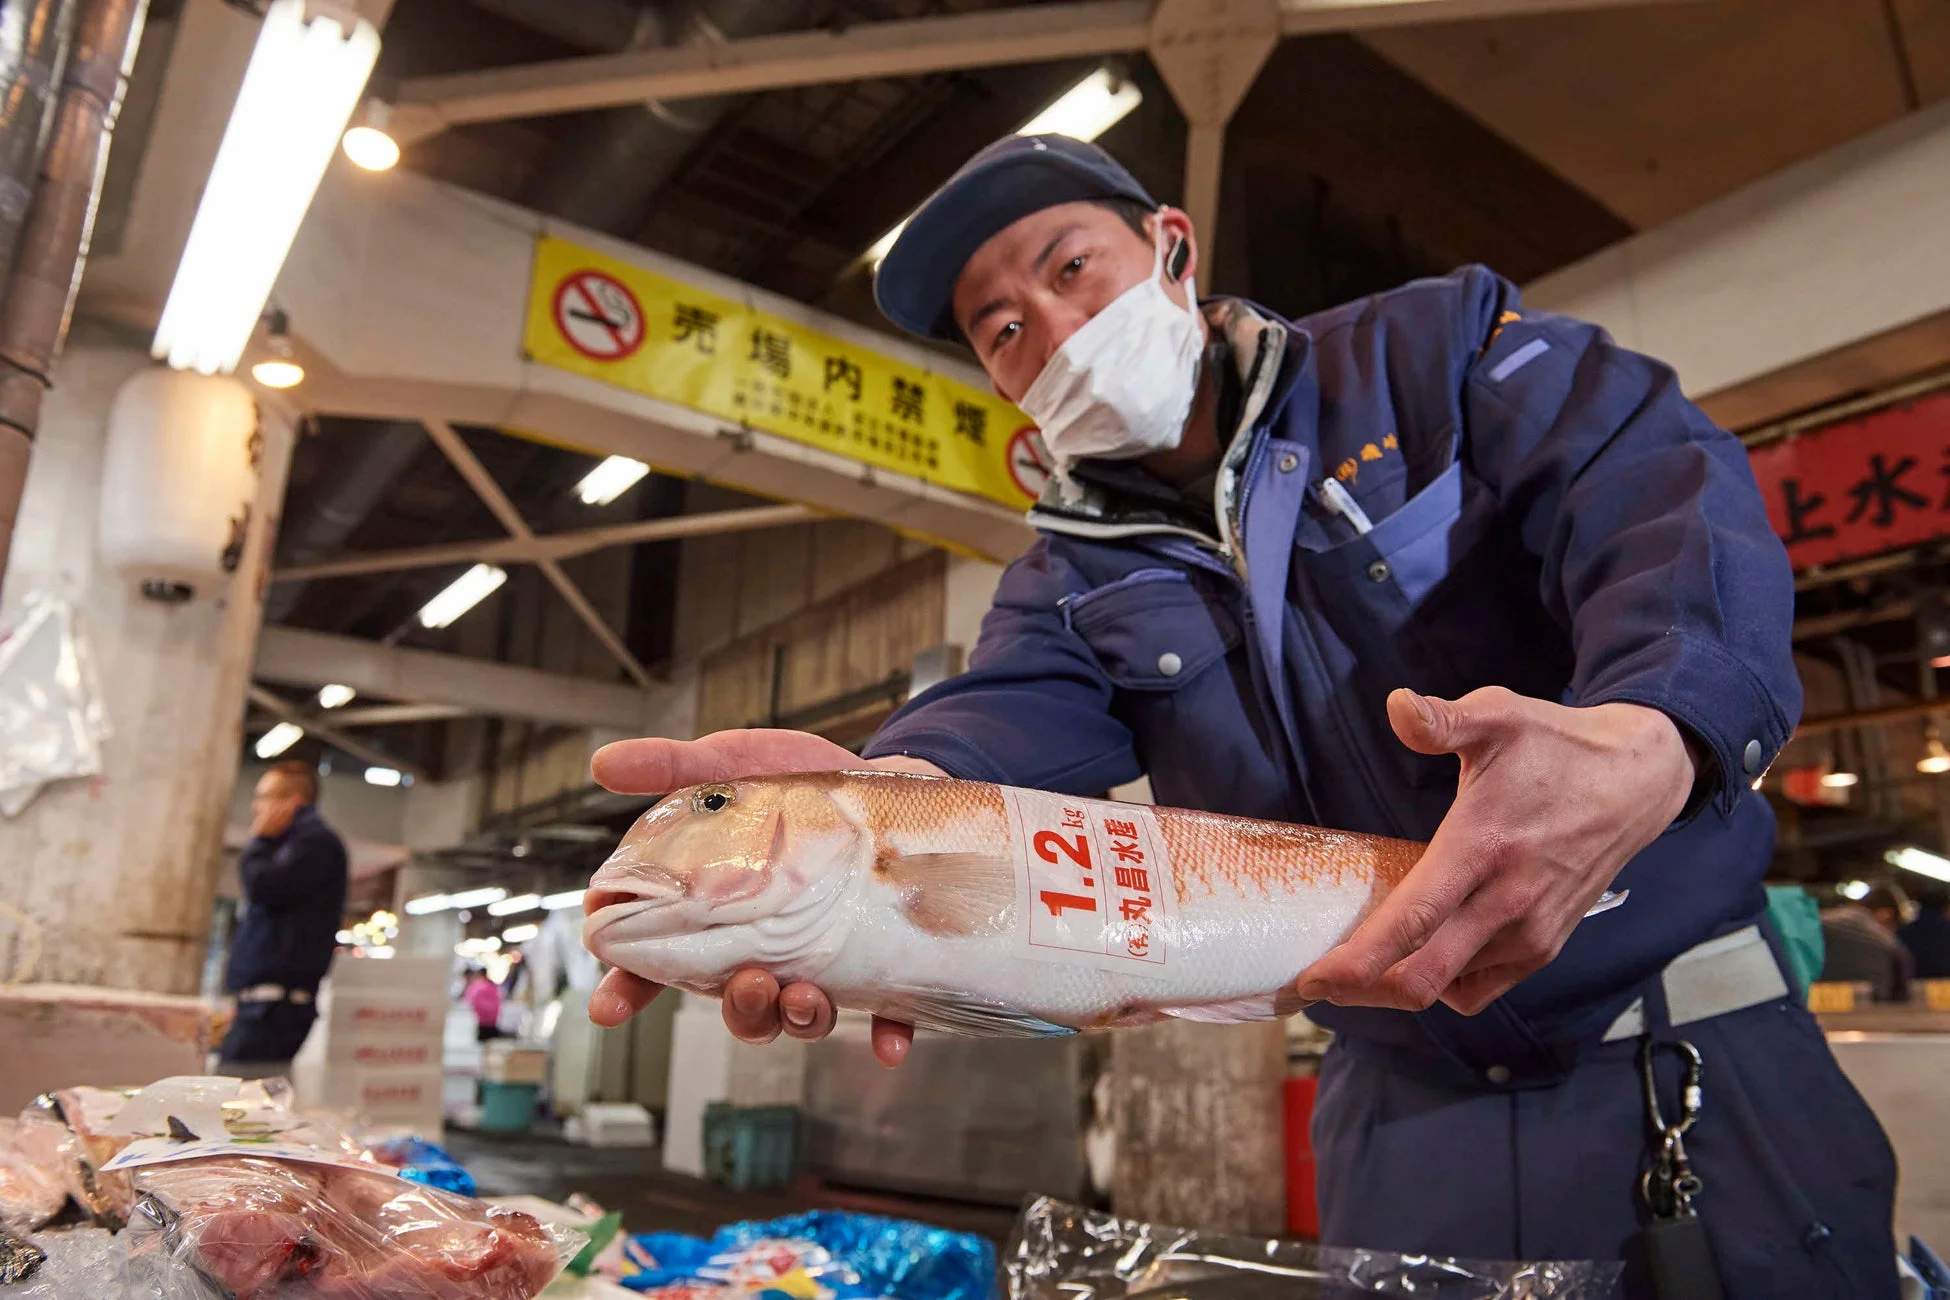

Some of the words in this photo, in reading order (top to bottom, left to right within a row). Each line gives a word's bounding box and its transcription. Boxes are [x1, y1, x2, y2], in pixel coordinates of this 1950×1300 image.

[672, 302, 988, 447] 売場内禁煙
[1780, 445, 1950, 545] 上水
